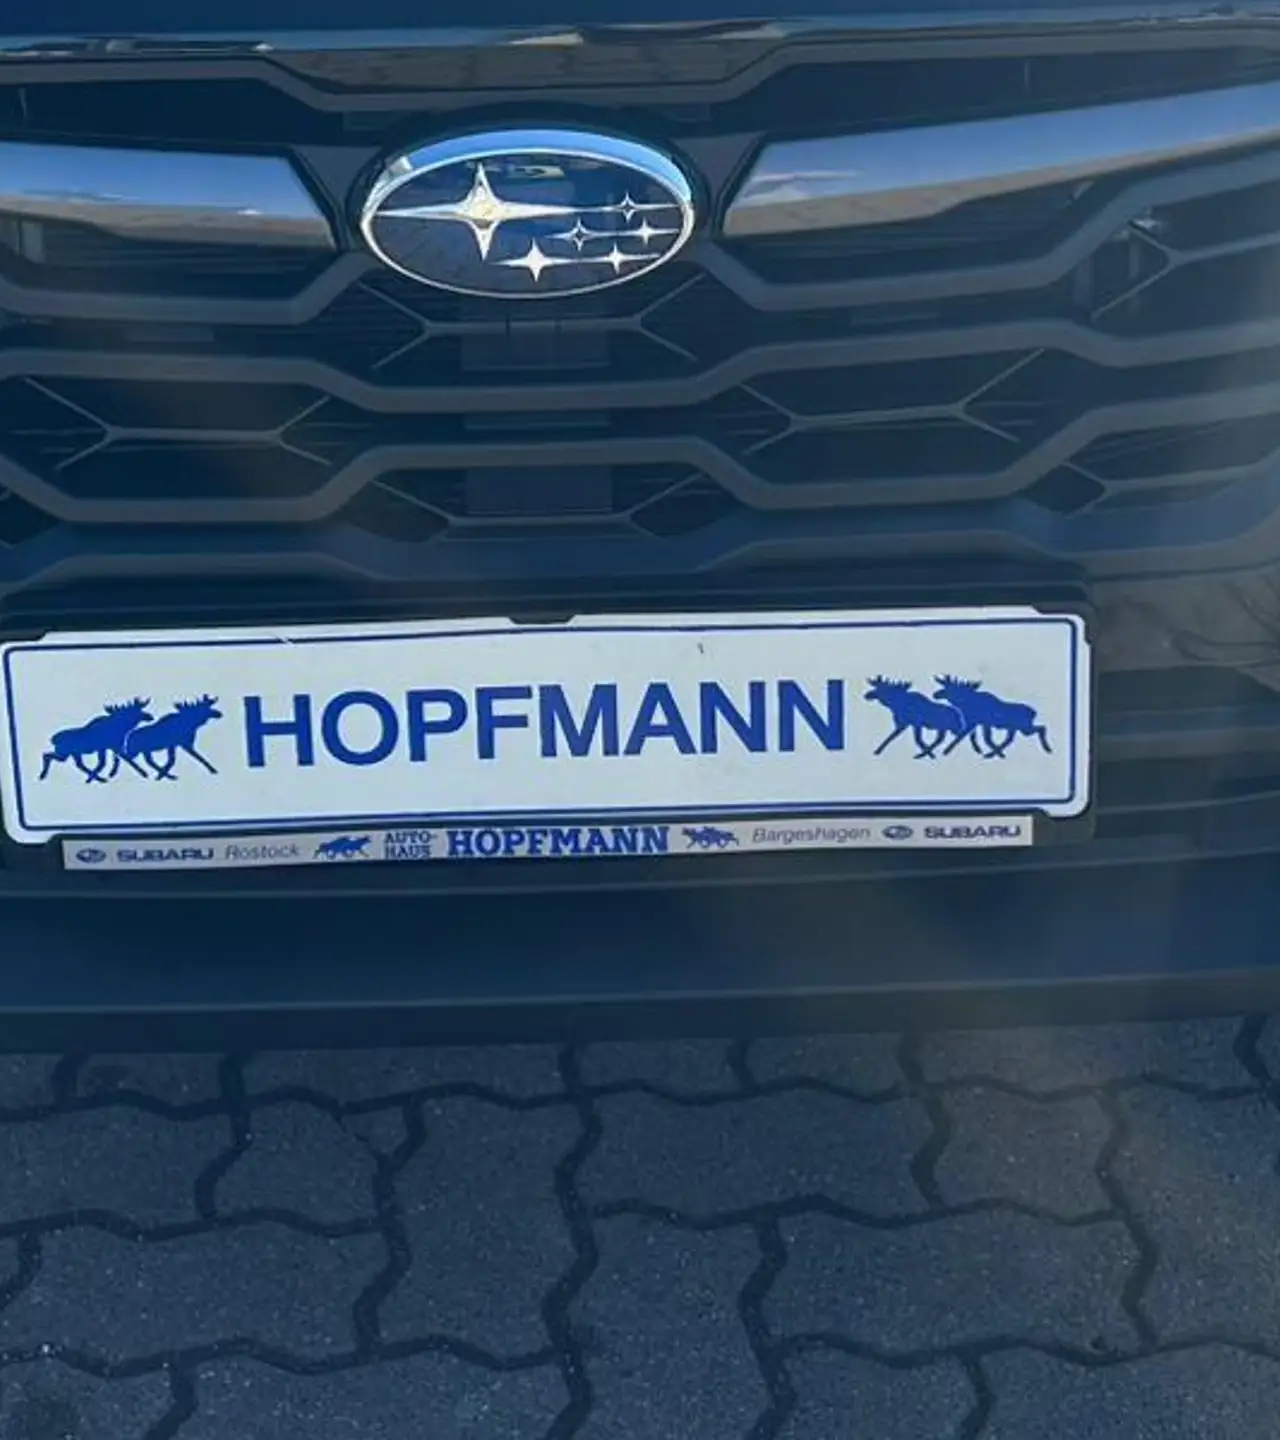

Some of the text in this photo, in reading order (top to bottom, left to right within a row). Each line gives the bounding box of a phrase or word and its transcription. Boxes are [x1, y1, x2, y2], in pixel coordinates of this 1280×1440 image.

[243, 679, 845, 768] HOPFMANN
[384, 831, 437, 845] AUTO-
[446, 825, 670, 857] HOPFMANN
[751, 824, 1023, 845] Bargeshagen SUBARU
[116, 843, 300, 862] SUBARU Rostock
[384, 844, 432, 860] HAUS
